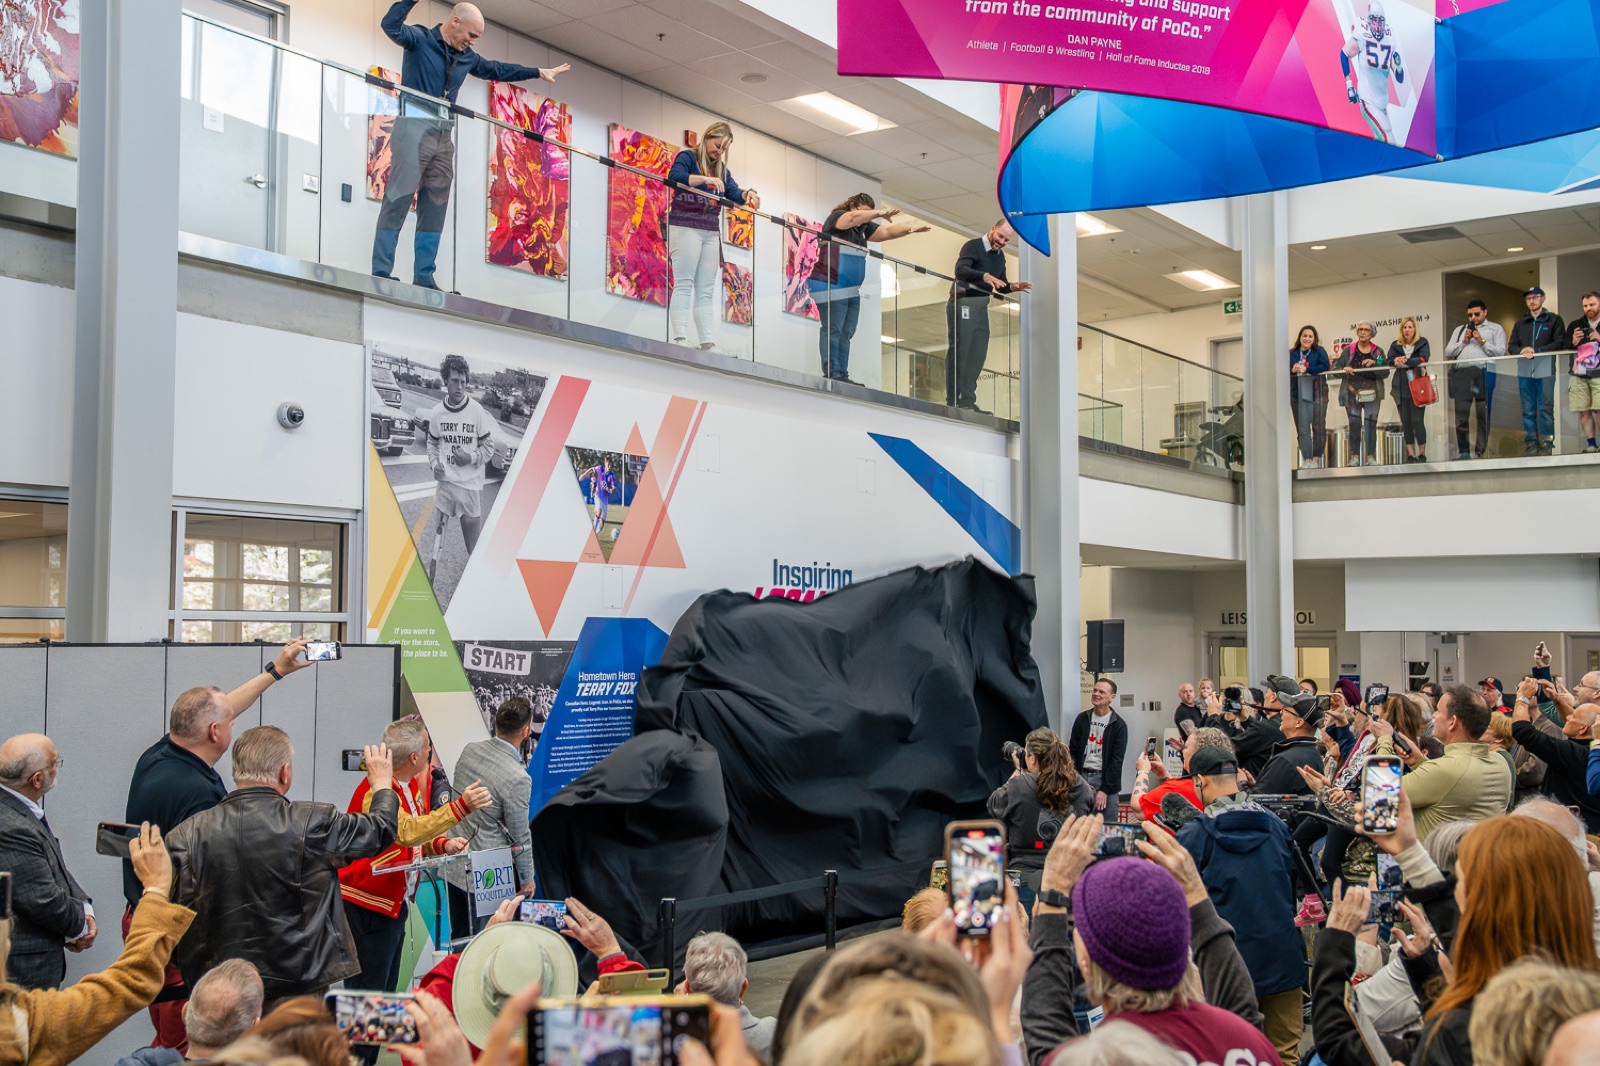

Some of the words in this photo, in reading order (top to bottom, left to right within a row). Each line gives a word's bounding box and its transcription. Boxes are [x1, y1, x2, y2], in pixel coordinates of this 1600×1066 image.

[965, 0, 1008, 14] from
[1012, 0, 1041, 17] the
[1045, 6, 1138, 31] community
[1141, 16, 1159, 31] of
[1172, 0, 1230, 20] support
[1067, 34, 1089, 46] DAN
[1090, 37, 1122, 49] PAYNE
[966, 40, 998, 50] Athlete
[1010, 42, 1045, 54] Football
[1047, 45, 1054, 54] &
[1056, 46, 1095, 60] Wrestling
[1106, 52, 1122, 62] Hall
[1123, 55, 1132, 63] of
[1134, 55, 1156, 66] Fame
[1157, 59, 1190, 71] Inductee
[1191, 65, 1211, 75] 2018
[1366, 40, 1391, 70] 57
[440, 422, 459, 432] TERRY
[462, 422, 475, 433] FOX
[440, 435, 474, 445] MARATHON
[773, 559, 852, 593] Inspiring
[1221, 612, 1247, 625] LEIS
[394, 627, 400, 635] If
[400, 628, 412, 636] you
[423, 639, 440, 647] stars,
[414, 650, 431, 658] place
[471, 647, 527, 672] START
[578, 671, 617, 682] Hometown
[619, 671, 636, 680] Hero
[576, 682, 614, 697] TERRY
[612, 681, 638, 695] FOX
[474, 866, 513, 889] PORT
[476, 887, 515, 901] COQUITLAM
